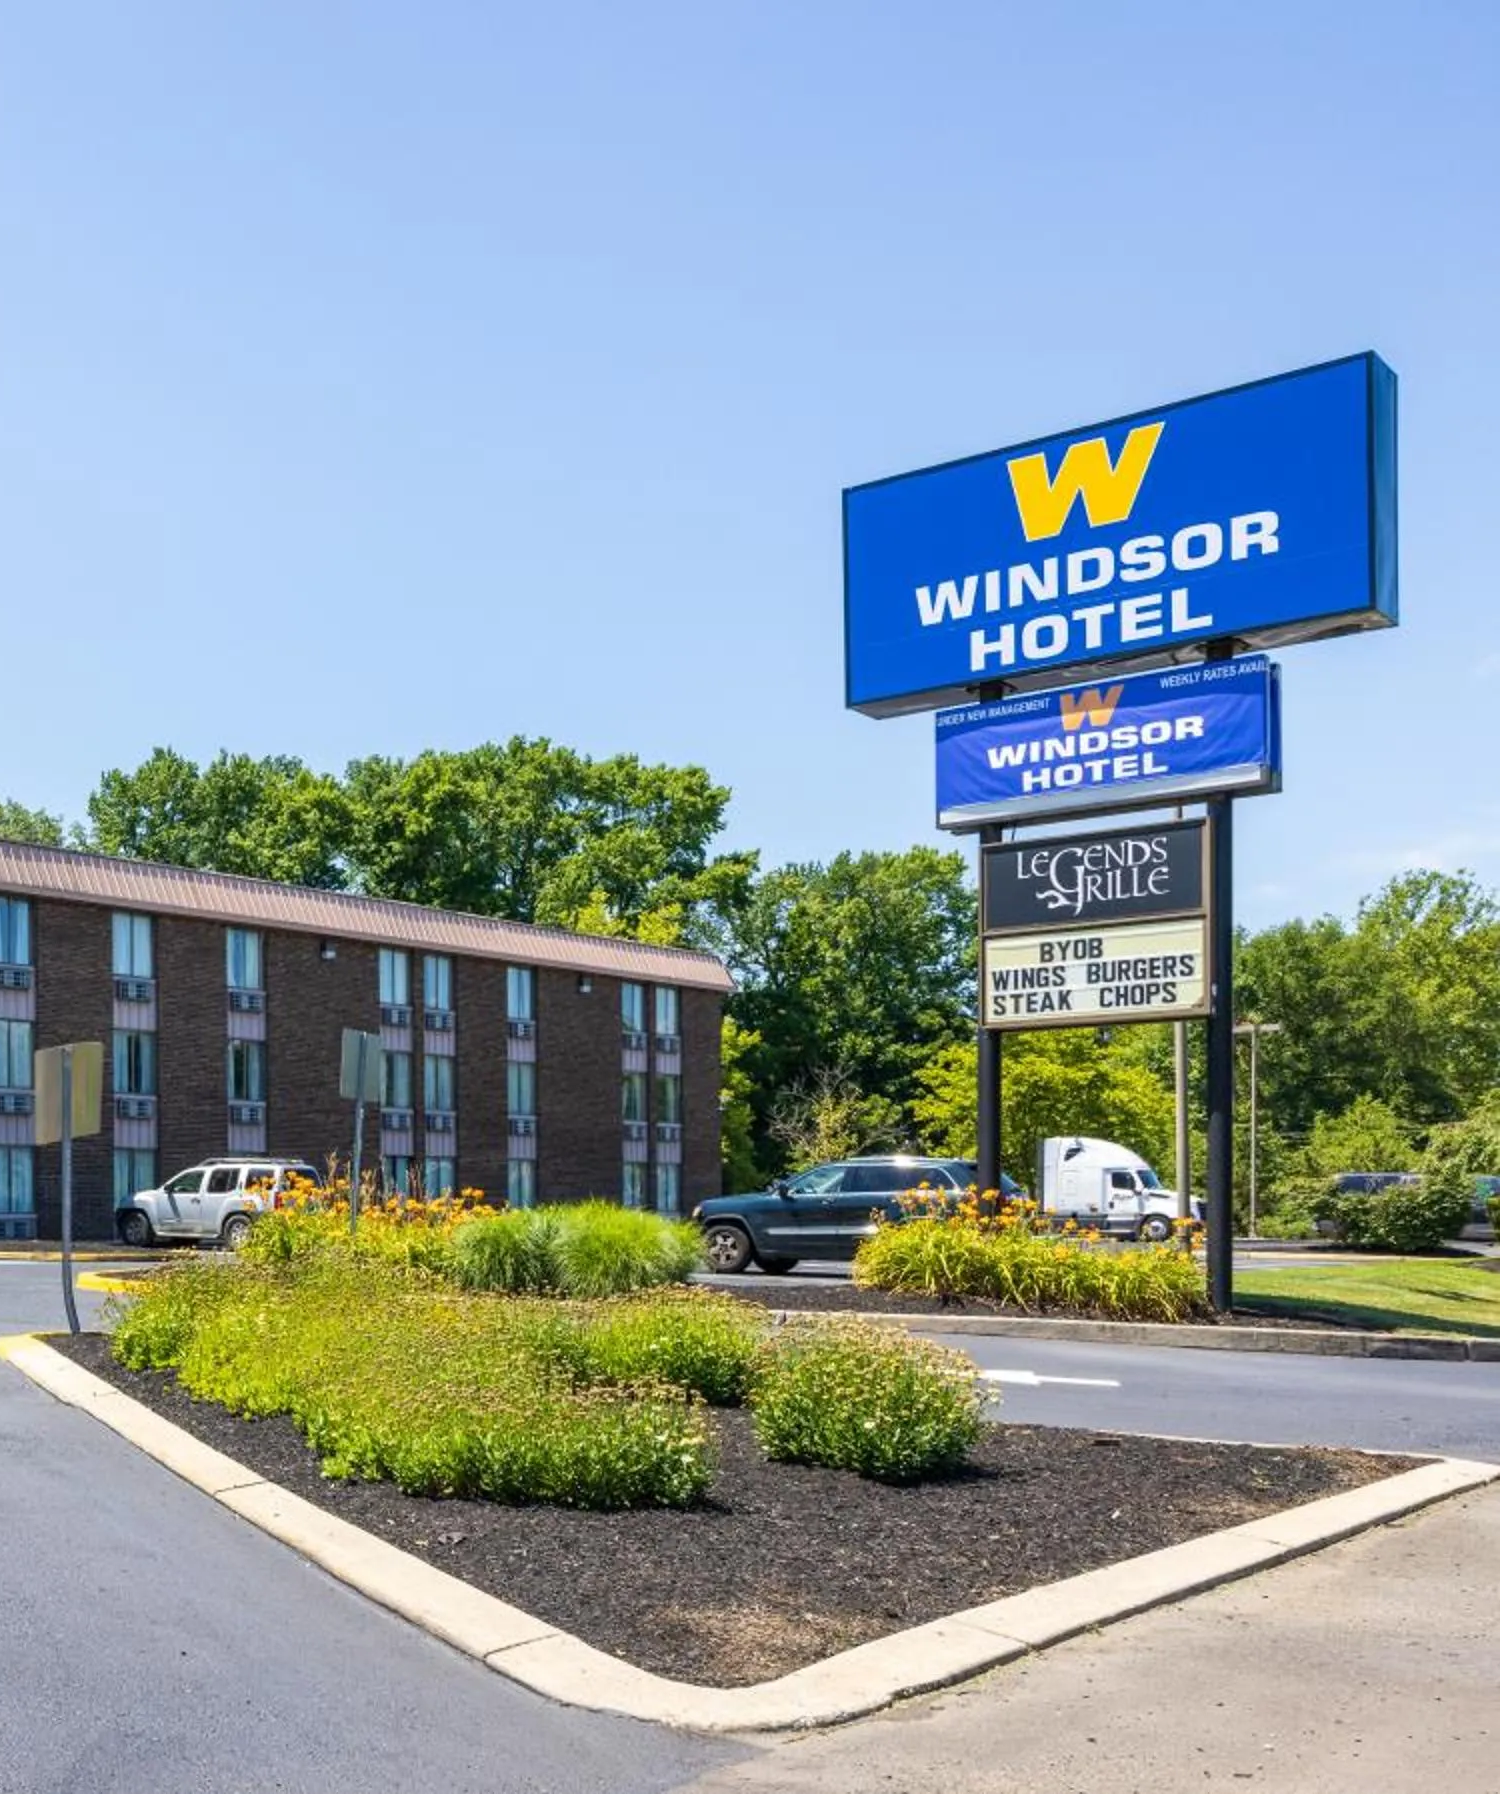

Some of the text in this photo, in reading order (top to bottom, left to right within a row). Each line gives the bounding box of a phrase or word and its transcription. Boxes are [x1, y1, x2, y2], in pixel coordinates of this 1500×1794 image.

[1006, 421, 1166, 543] W
[915, 510, 1279, 626] WINDSOR
[970, 588, 1213, 672] HOTEL
[1160, 671, 1201, 689] WEEKLY
[1203, 665, 1237, 682] RATES
[966, 709, 987, 721] NEW
[988, 697, 1051, 719] MANAGEMENT
[1059, 684, 1125, 732] W
[987, 715, 1205, 769] WINDSOR
[1022, 752, 1168, 793] HOTEL
[1040, 938, 1104, 963] BYOB
[992, 954, 1195, 992] WINGS BURGERS
[993, 982, 1177, 1016] STEAK CHOPS
